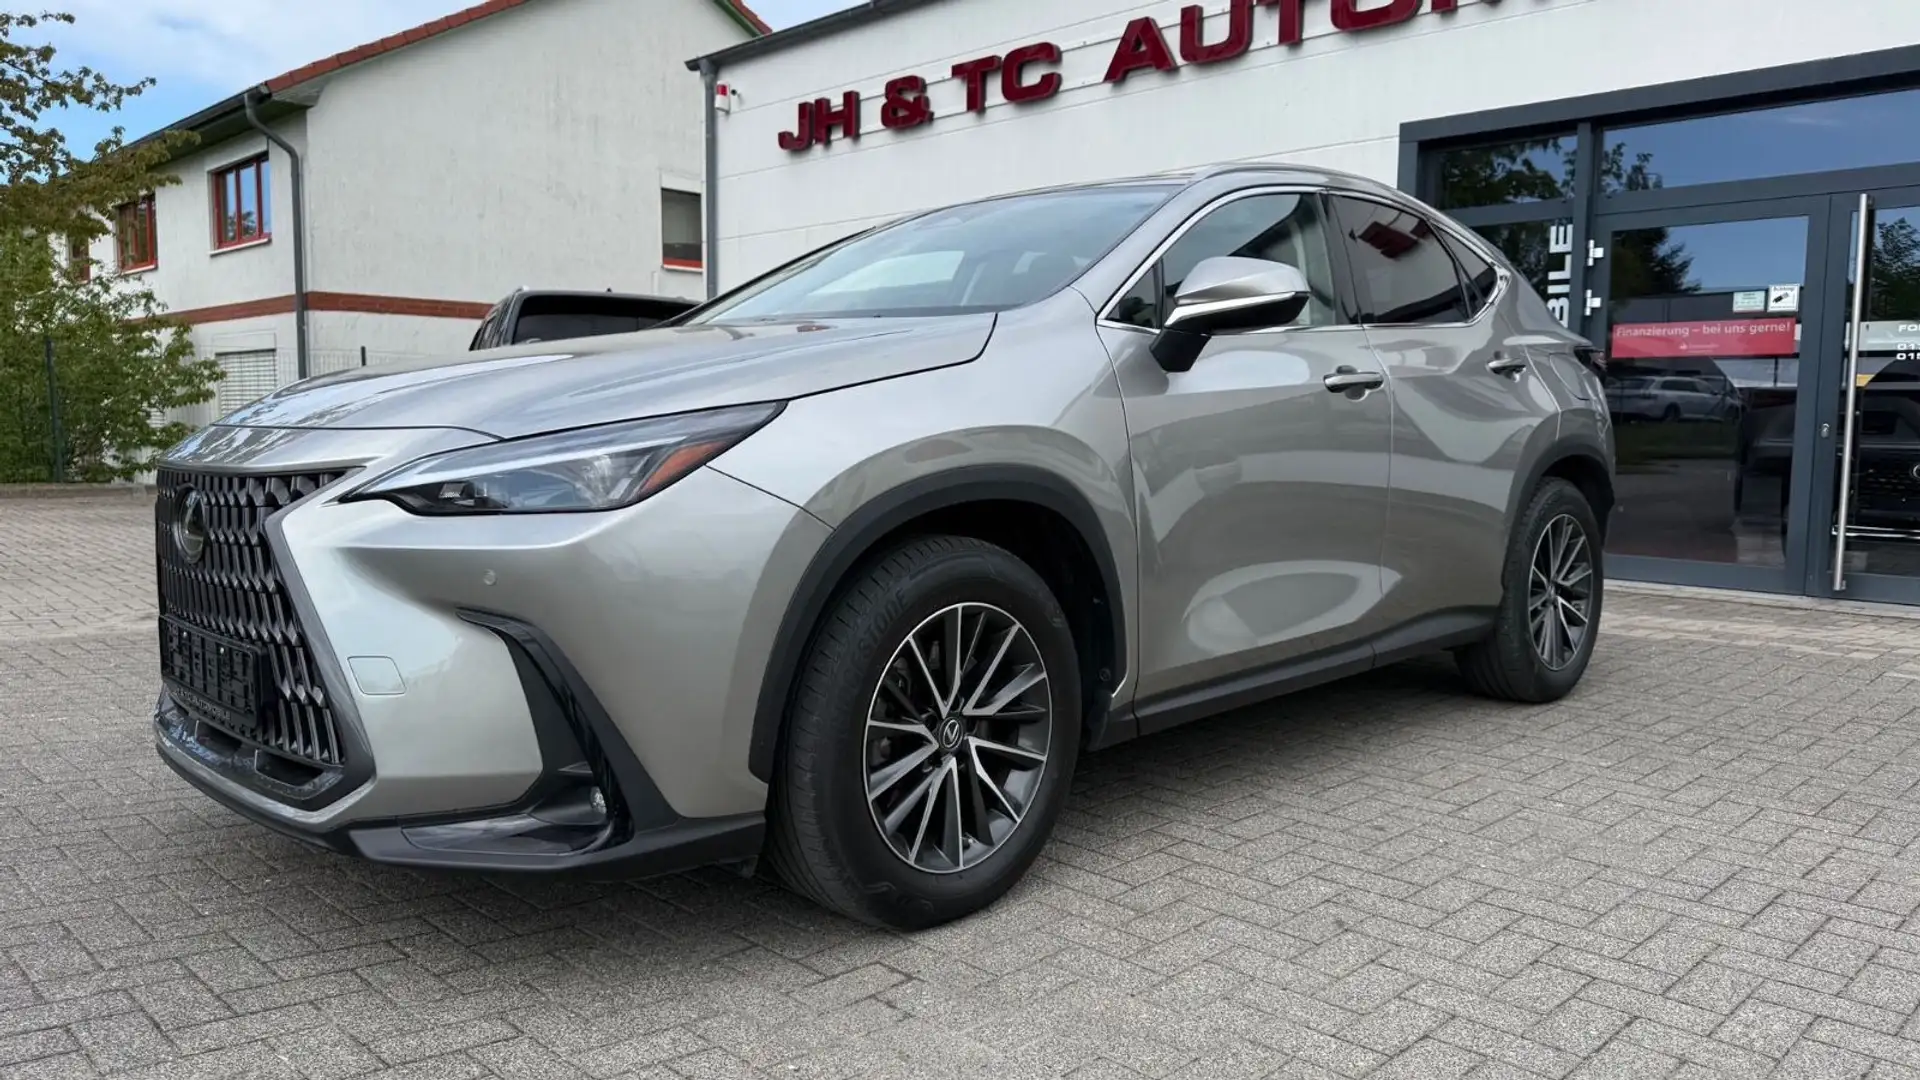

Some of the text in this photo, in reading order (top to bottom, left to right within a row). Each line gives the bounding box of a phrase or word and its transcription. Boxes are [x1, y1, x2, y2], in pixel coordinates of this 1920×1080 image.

[778, 0, 1501, 151] JH & TC AUT
[1616, 325, 1690, 337] Finanzierung
[1702, 323, 1721, 334] bei
[1724, 324, 1746, 333] uns
[1750, 321, 1791, 335] gerne!
[1898, 323, 1920, 333] FO
